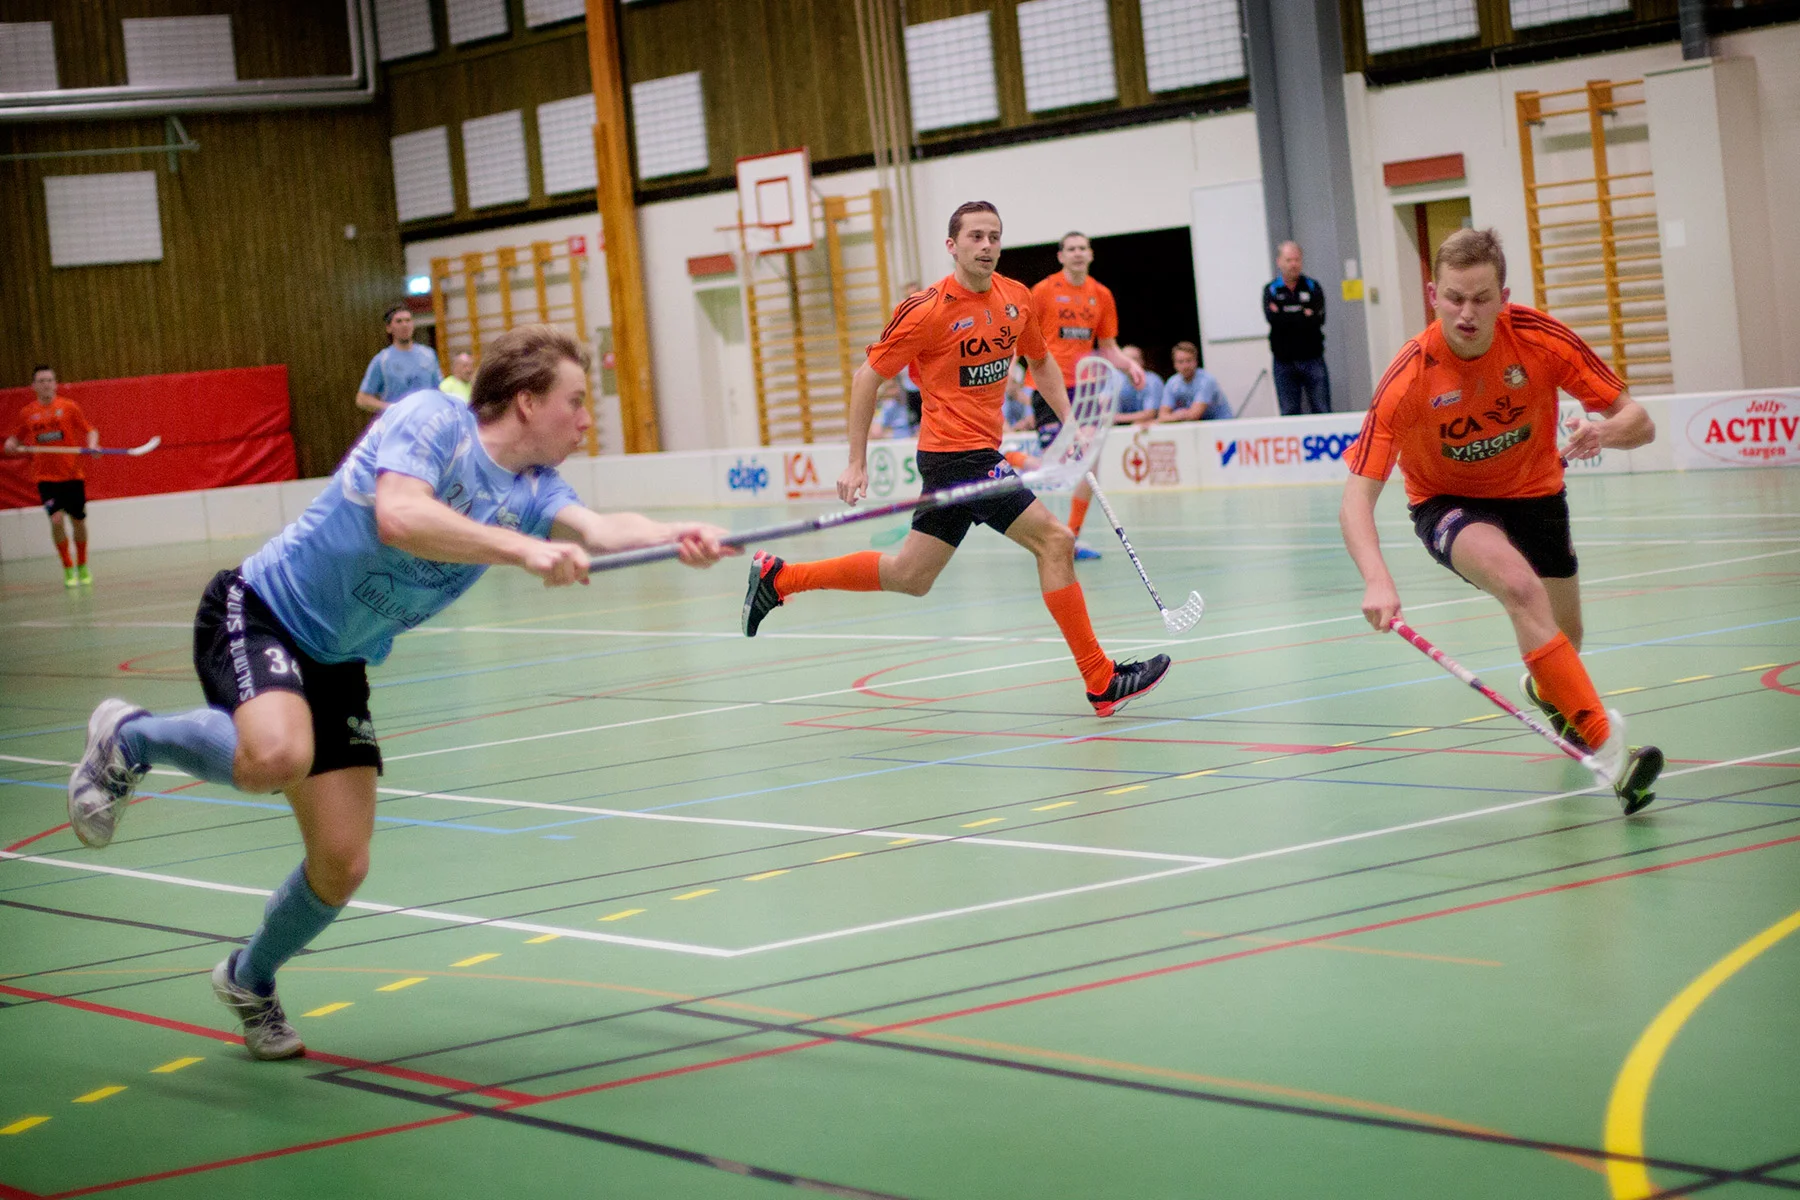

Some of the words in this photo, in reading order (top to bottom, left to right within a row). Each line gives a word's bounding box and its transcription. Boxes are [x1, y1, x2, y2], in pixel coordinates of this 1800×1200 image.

[960, 337, 991, 358] ICA
[968, 358, 1010, 378] VISION
[1440, 415, 1483, 439] ICA
[1451, 429, 1519, 456] VISION
[783, 452, 818, 486] ICA
